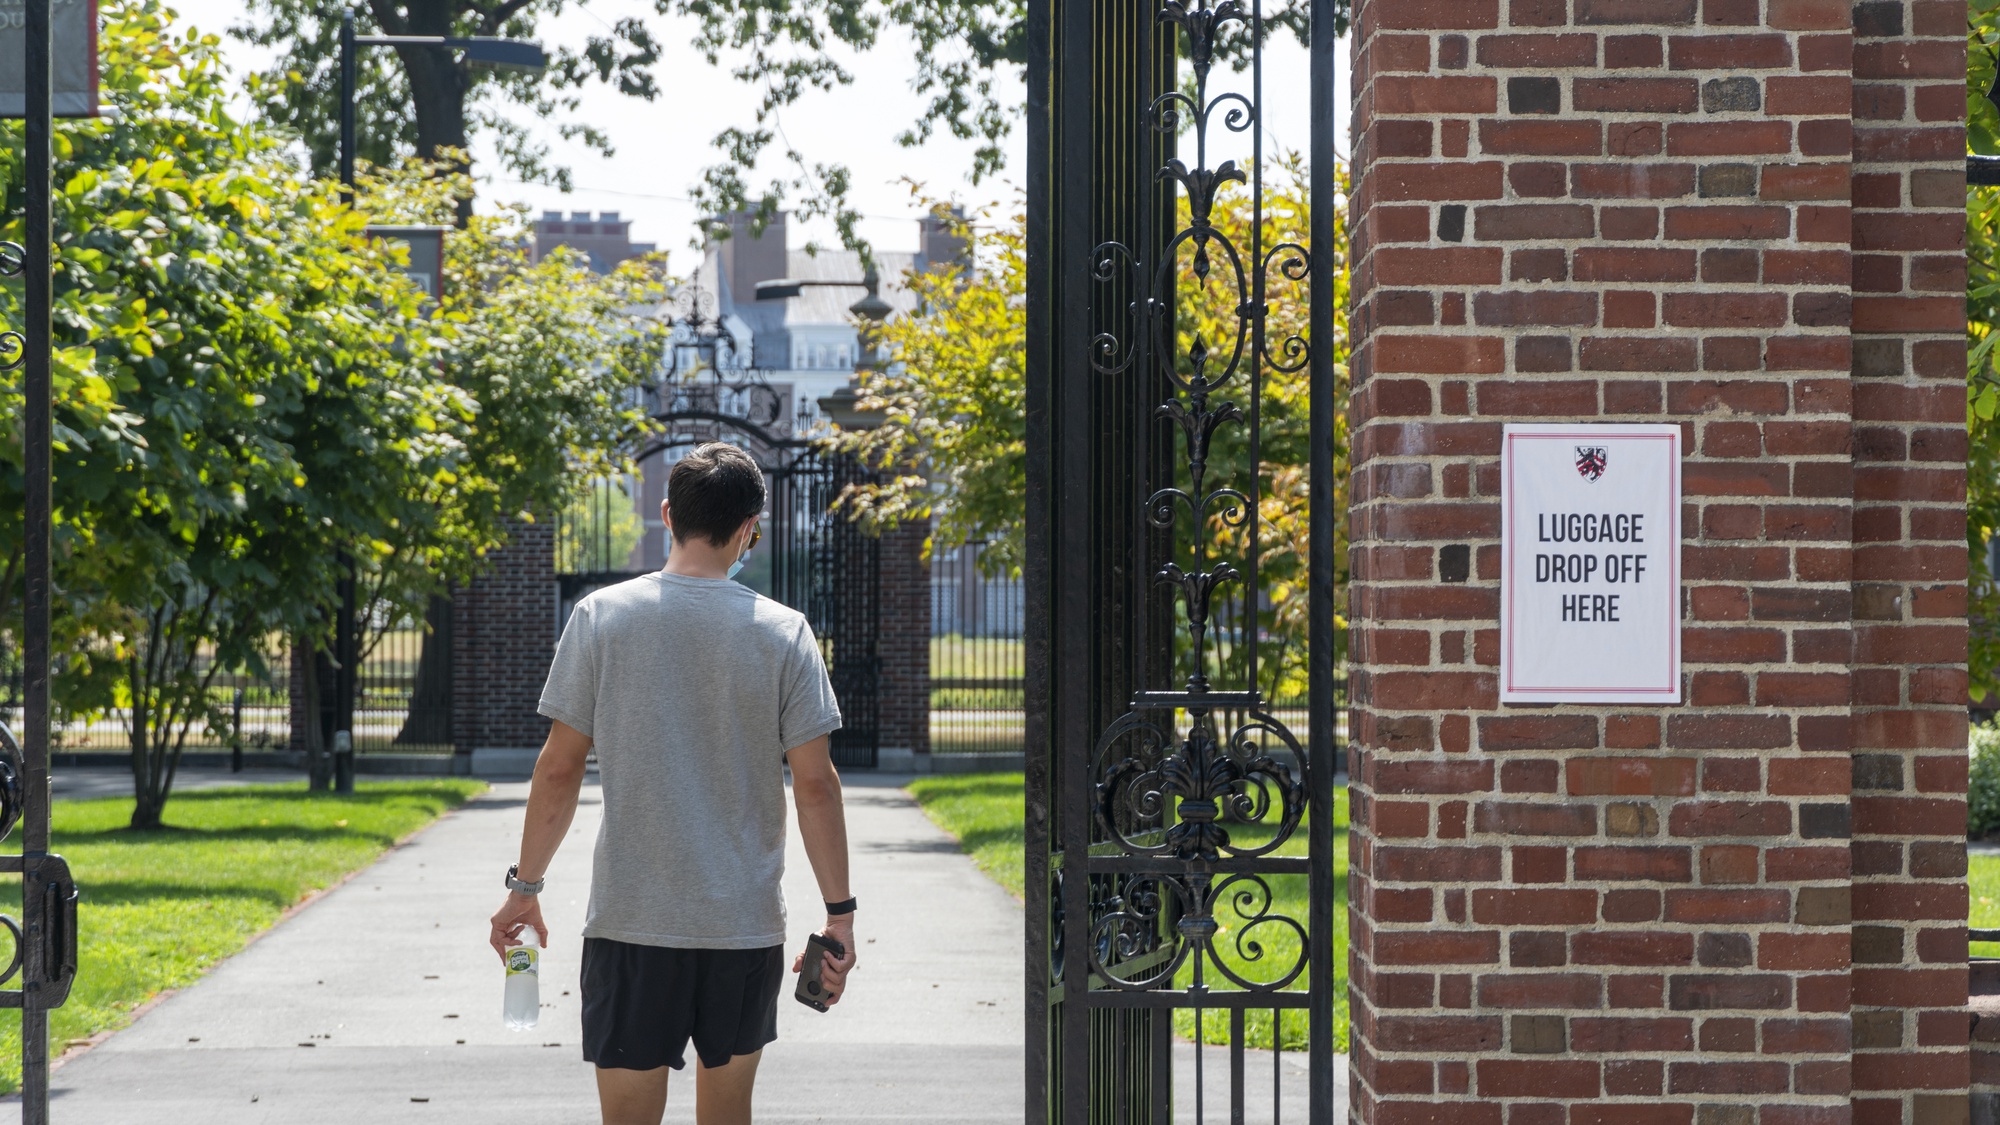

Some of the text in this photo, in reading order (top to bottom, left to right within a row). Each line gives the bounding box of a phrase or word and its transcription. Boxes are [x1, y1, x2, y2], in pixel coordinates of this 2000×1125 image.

[1539, 513, 1644, 543] LUGGAGE
[1536, 554, 1648, 583] DROP OFF
[1563, 594, 1620, 622] HERE
